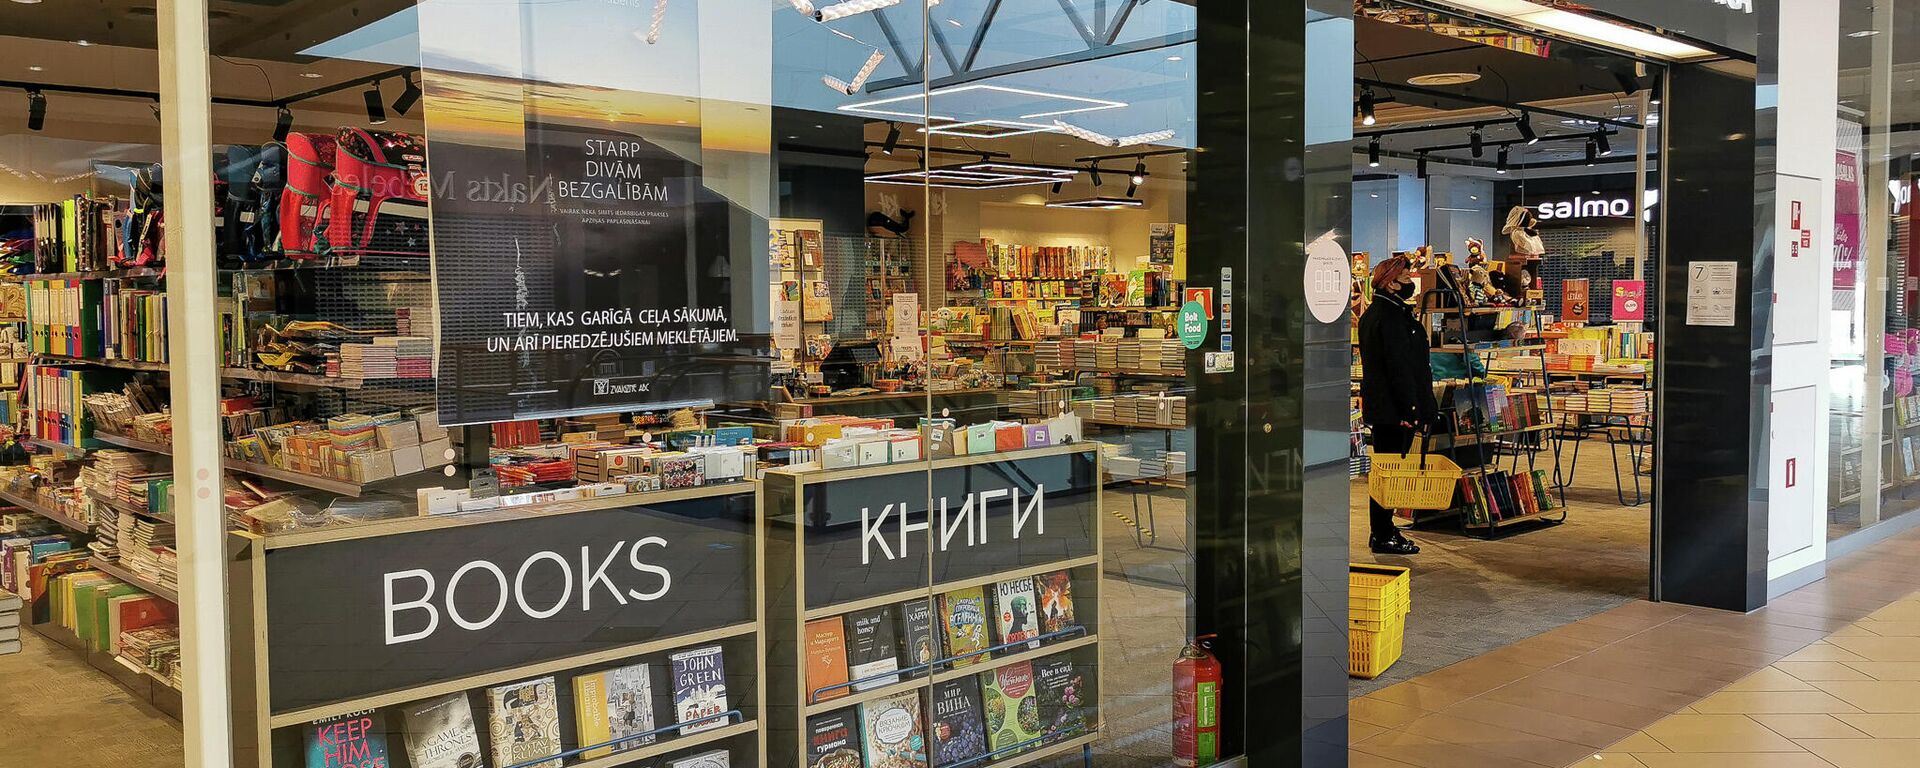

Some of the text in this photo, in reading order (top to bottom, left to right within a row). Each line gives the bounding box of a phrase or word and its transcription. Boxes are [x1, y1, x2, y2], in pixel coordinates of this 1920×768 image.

[585, 139, 640, 158] STARP
[586, 160, 641, 179] DIVĀM
[558, 181, 669, 202] BEZGALĪBĀM
[1538, 196, 1629, 219] salmo
[1695, 266, 1704, 280] 7
[503, 306, 727, 329] TIEM, KAS GARĪGĀ CEĻA SĀKUMĀ,
[1184, 312, 1198, 322] Bolt
[1184, 322, 1201, 333] Food
[487, 336, 511, 352] UN
[514, 334, 539, 351] ARĪ
[542, 331, 654, 350] PIEREDZĒJUŠIEM
[861, 483, 1044, 565] КНИГИ
[383, 536, 672, 645] BOOKS
[870, 615, 881, 624] and
[680, 655, 714, 672] JOHN
[680, 668, 722, 687] GREEN
[943, 688, 961, 700] МИР
[937, 695, 972, 715] ВИНА
[318, 717, 372, 747] KEEP
[324, 738, 371, 768] HIM
[425, 734, 472, 759] THRONES
